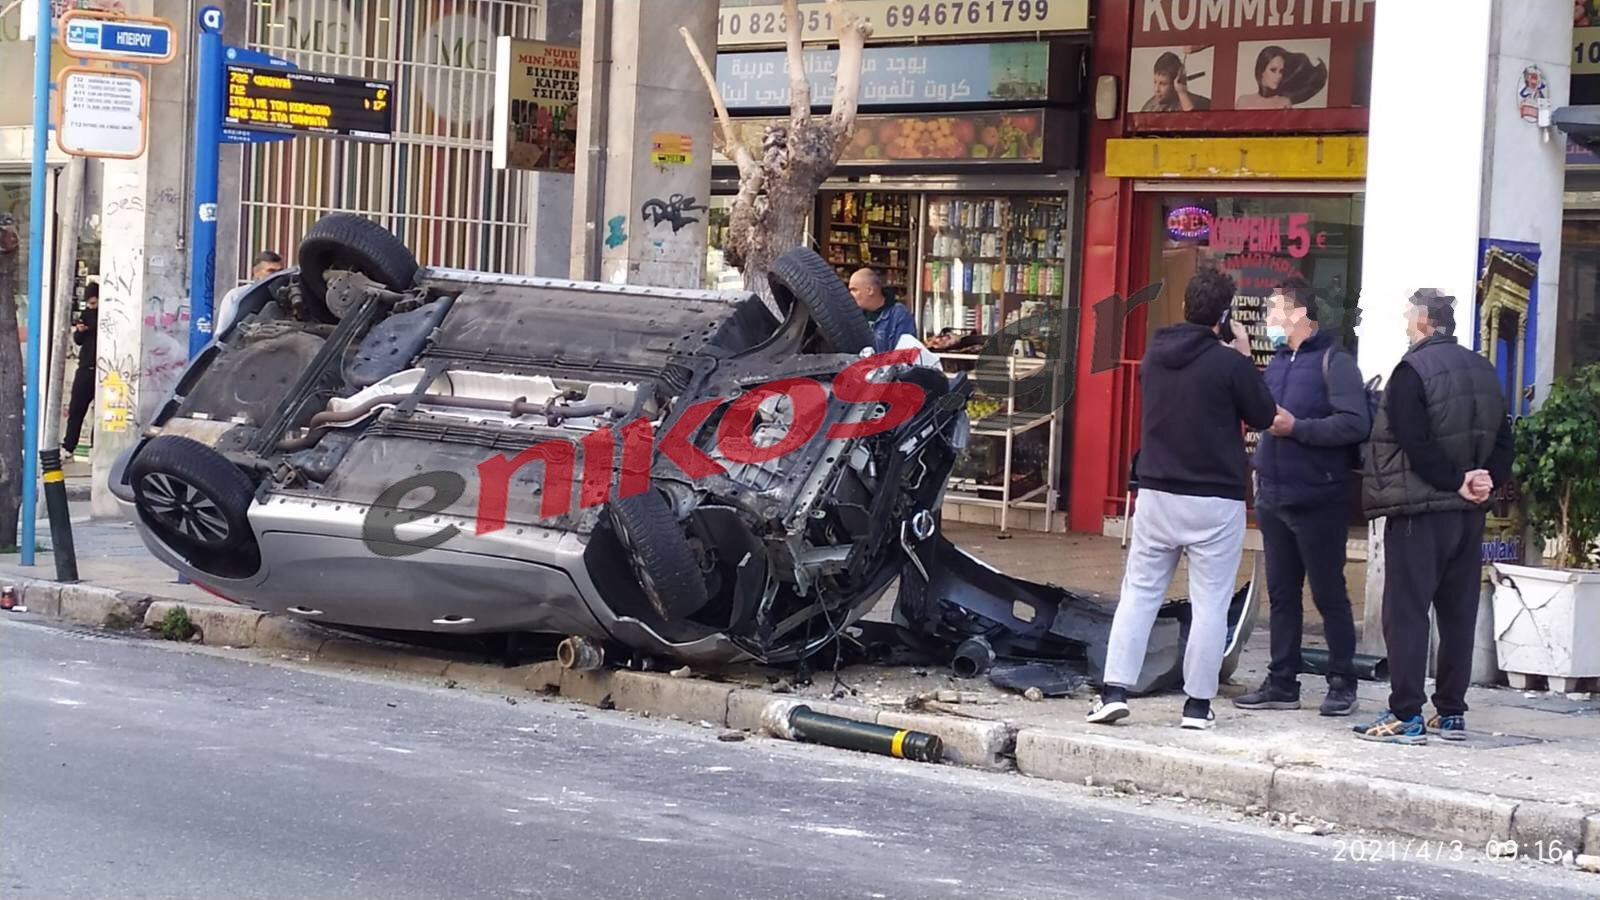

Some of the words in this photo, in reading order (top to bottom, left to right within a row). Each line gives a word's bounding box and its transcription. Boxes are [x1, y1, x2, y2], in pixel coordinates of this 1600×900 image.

[886, 0, 1049, 27] 6946761799
[116, 31, 152, 47] ΗΠΕΙΡΟΥ
[544, 47, 577, 59] NURU
[1287, 213, 1311, 259] 5
[1316, 231, 1328, 249] €
